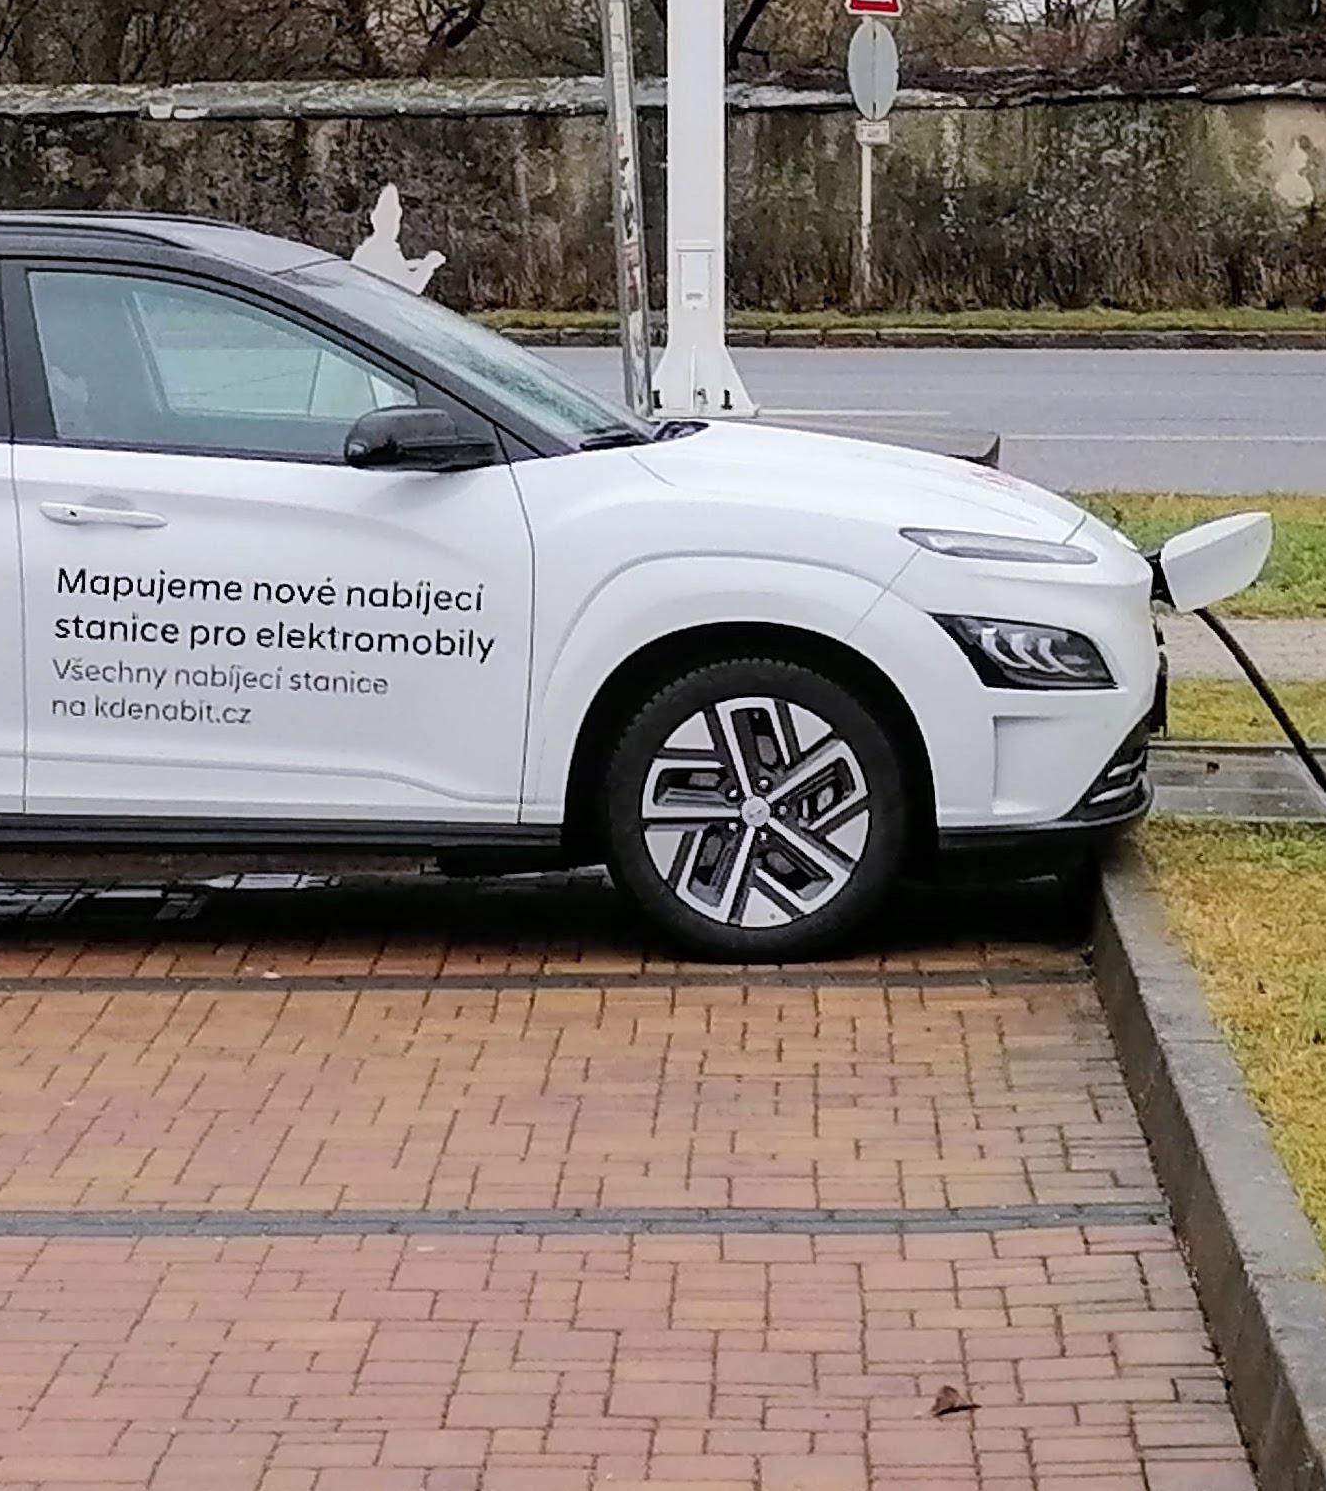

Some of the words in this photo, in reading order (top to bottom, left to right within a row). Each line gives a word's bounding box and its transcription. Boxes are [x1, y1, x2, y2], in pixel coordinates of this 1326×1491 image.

[57, 567, 243, 605] Mapujeme
[253, 576, 337, 606] nové
[54, 613, 180, 644] stanice
[190, 624, 246, 650] pro
[256, 621, 495, 664] elektromobily
[52, 657, 168, 689] Všechny
[289, 670, 389, 695] stanice
[52, 698, 86, 717] na
[94, 694, 252, 724] kdenabit.cz
